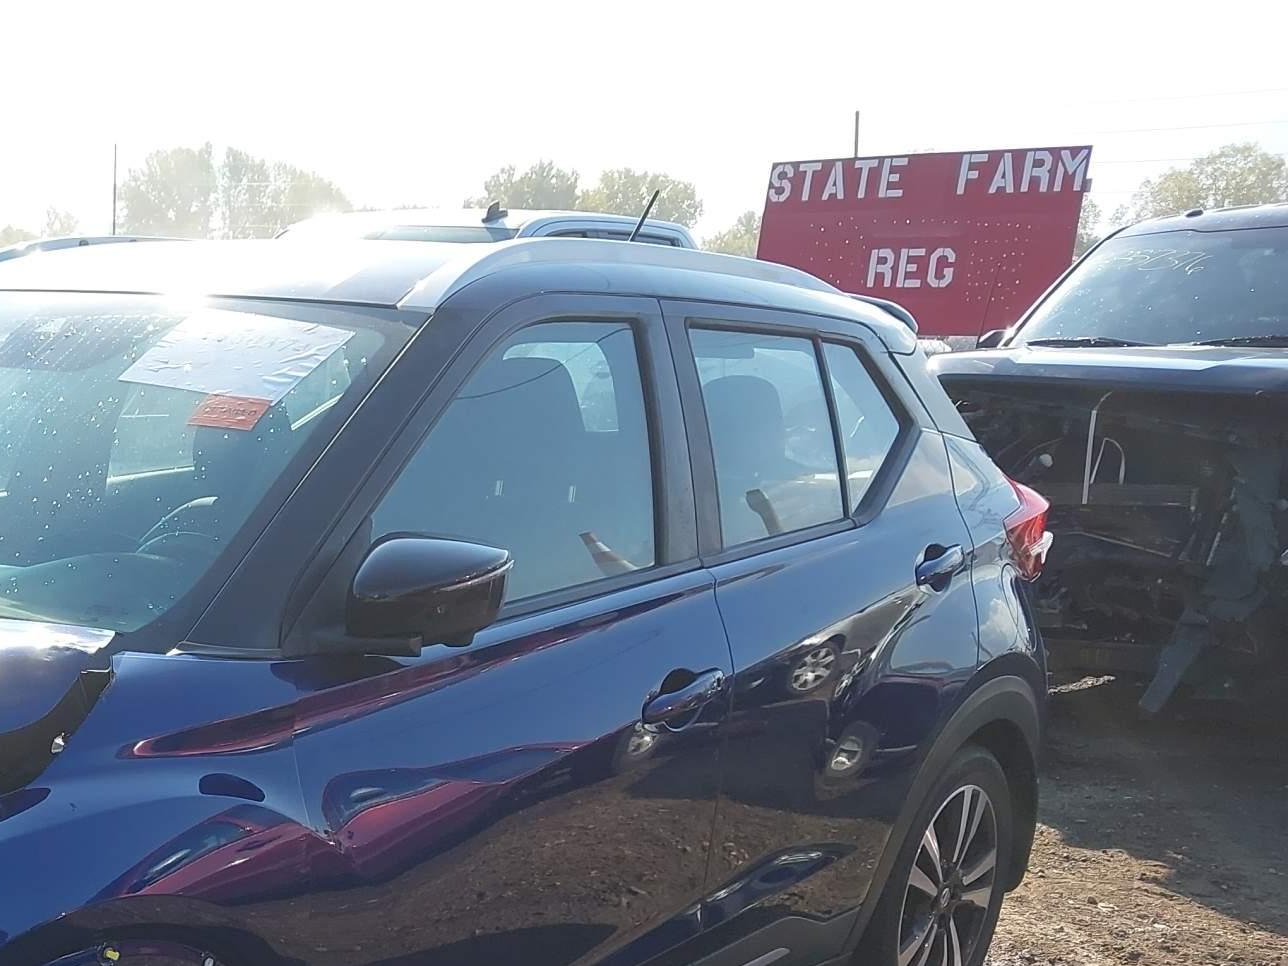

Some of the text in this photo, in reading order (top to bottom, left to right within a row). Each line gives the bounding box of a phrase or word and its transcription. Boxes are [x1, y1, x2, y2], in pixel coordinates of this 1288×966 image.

[768, 149, 1089, 202] STATE FARM
[866, 248, 956, 288] REG
